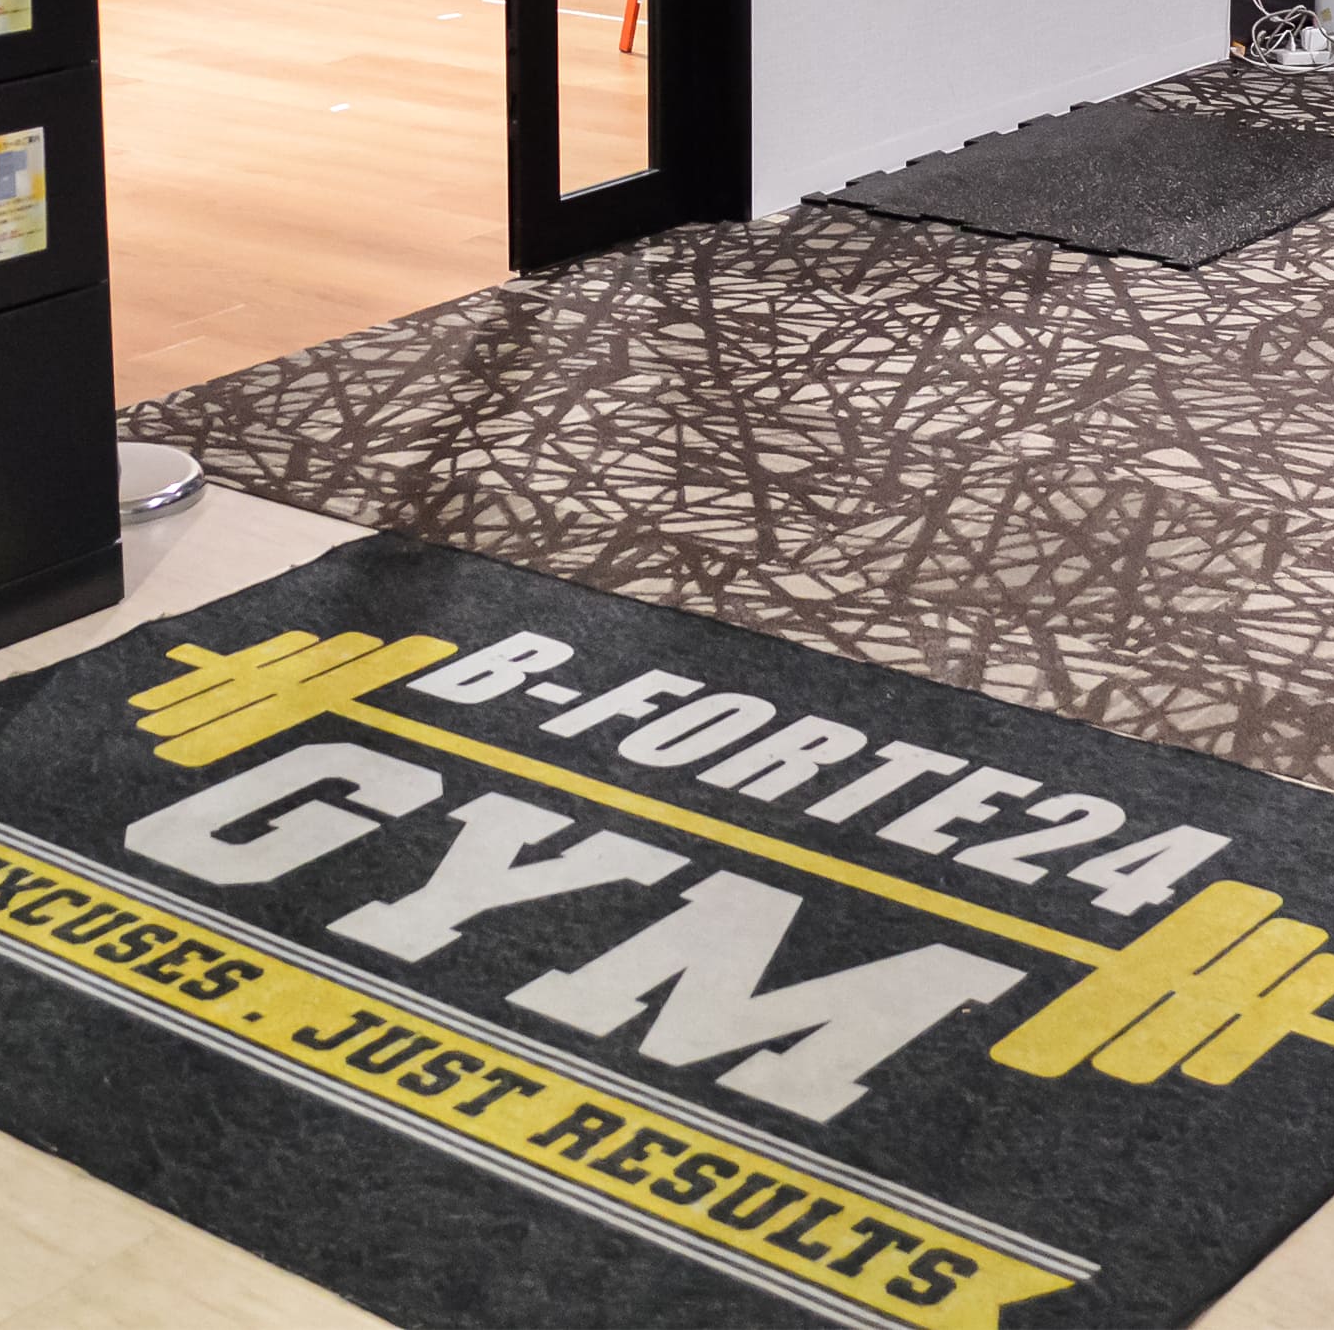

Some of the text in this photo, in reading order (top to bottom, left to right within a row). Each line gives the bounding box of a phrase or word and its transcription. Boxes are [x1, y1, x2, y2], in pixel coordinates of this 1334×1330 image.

[405, 630, 1233, 917] B-FORTE24
[124, 742, 1028, 1124] GYM
[291, 1008, 546, 1117] JUST
[532, 1100, 979, 1308] RESULTS
